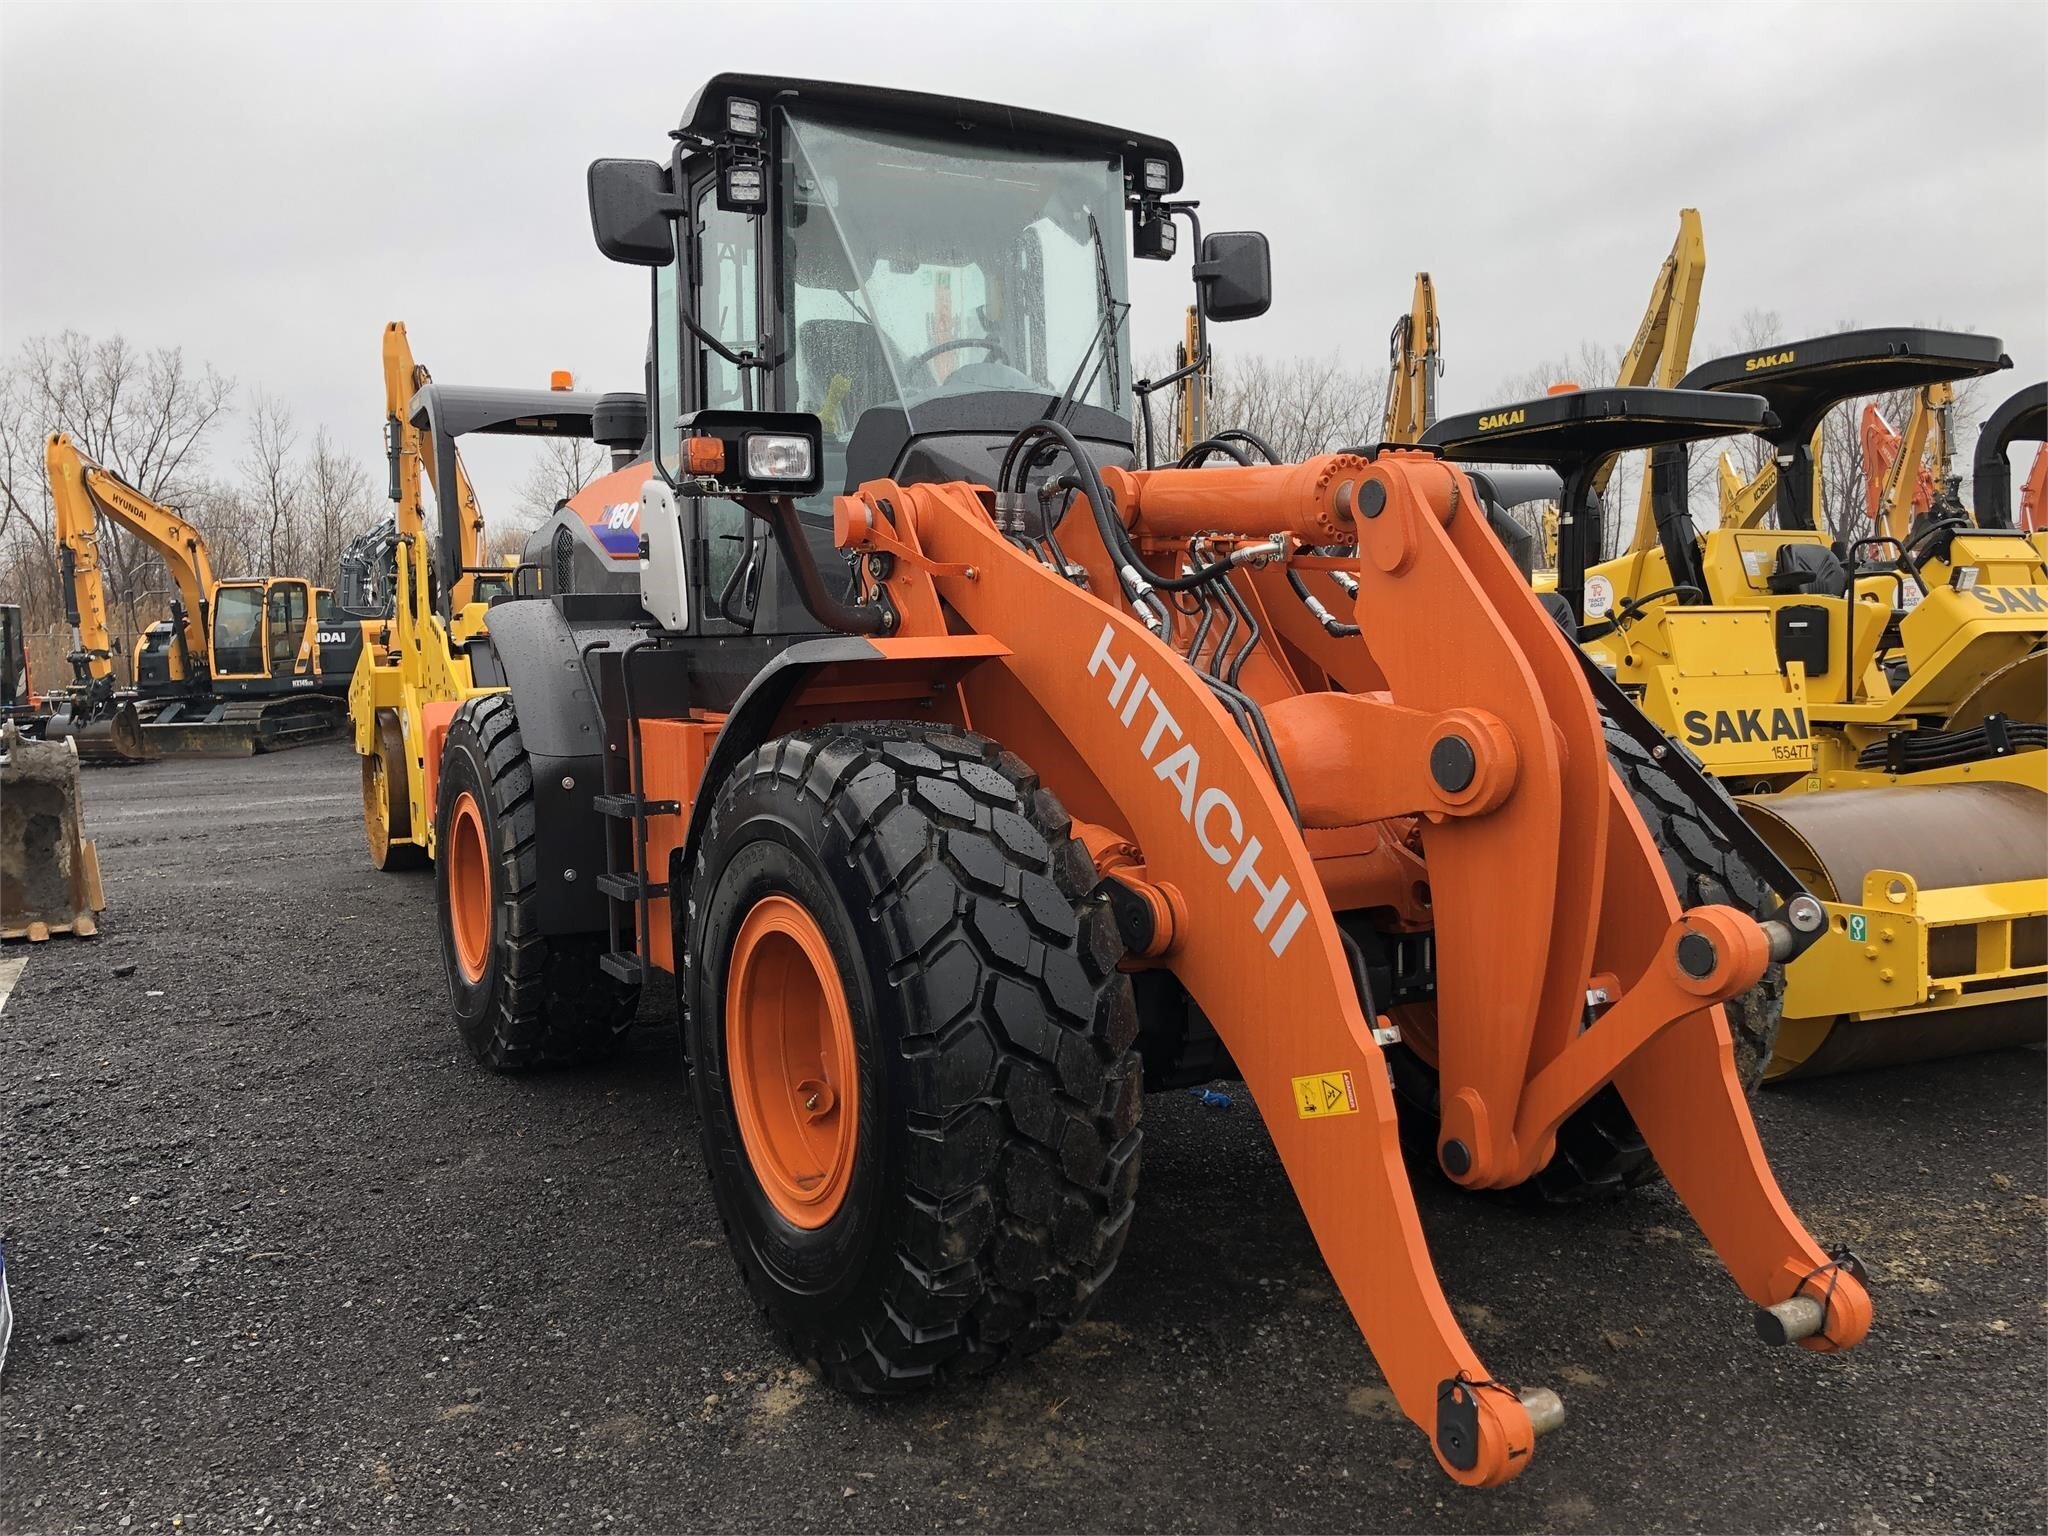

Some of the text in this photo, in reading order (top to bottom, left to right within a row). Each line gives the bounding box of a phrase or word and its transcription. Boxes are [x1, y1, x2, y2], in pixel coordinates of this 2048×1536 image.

[1744, 350, 1795, 372] SAKAI
[1478, 409, 1525, 431] SAKAI
[1753, 471, 1776, 503] KOBELCO
[112, 493, 147, 521] HYUNDAI
[1683, 707, 1809, 747] SAKAI
[1771, 744, 1809, 760] 155477
[1087, 622, 1308, 958] HITACHI
